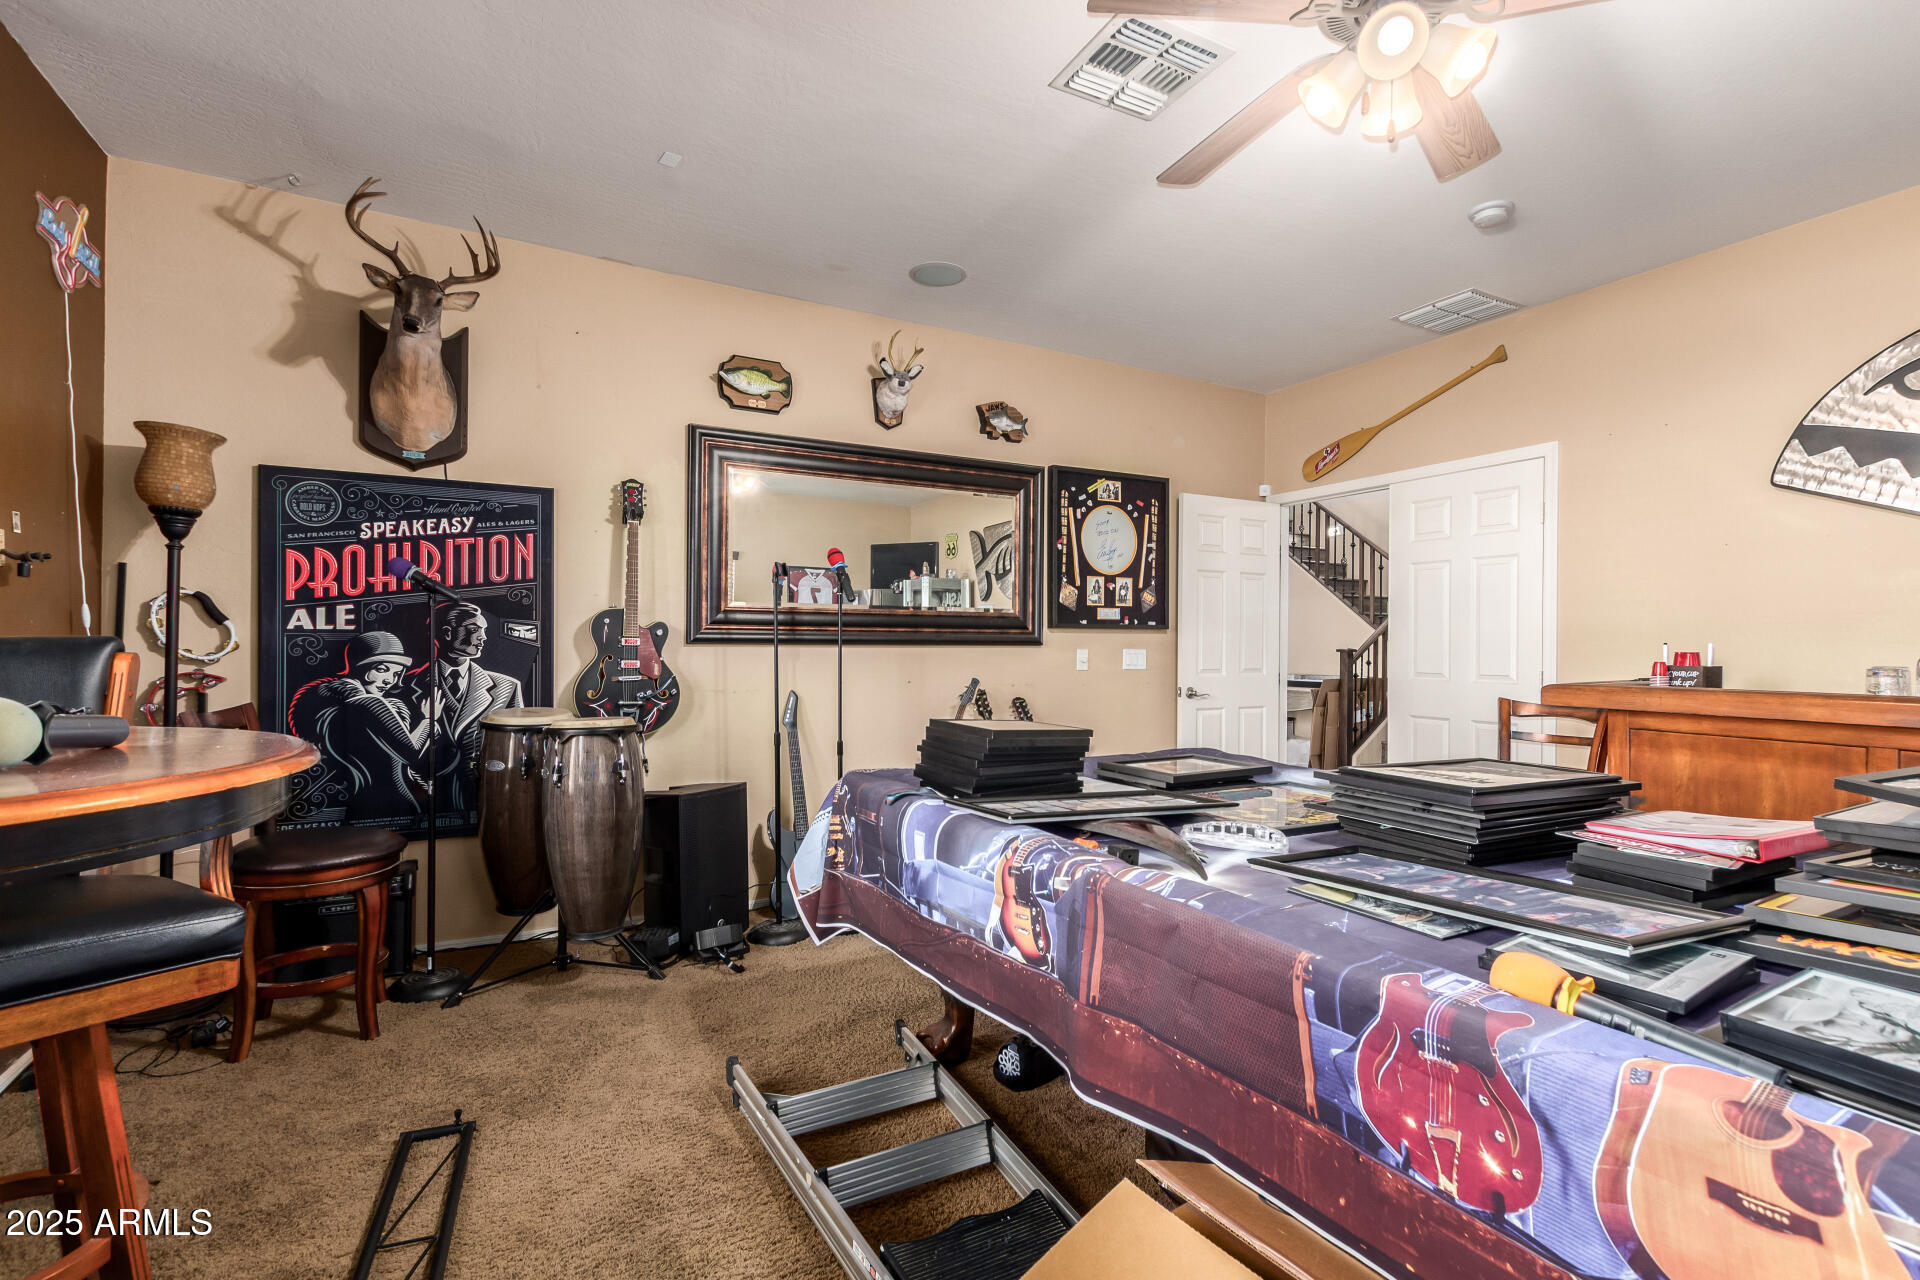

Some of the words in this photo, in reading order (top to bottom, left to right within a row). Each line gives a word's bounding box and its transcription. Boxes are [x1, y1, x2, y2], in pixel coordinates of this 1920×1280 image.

[307, 530, 356, 538] FRANCISCO
[360, 516, 474, 539] SPEAKEASY
[285, 532, 535, 601] PROHIBITION
[286, 603, 356, 630] ALE
[1683, 679, 1697, 687] up!
